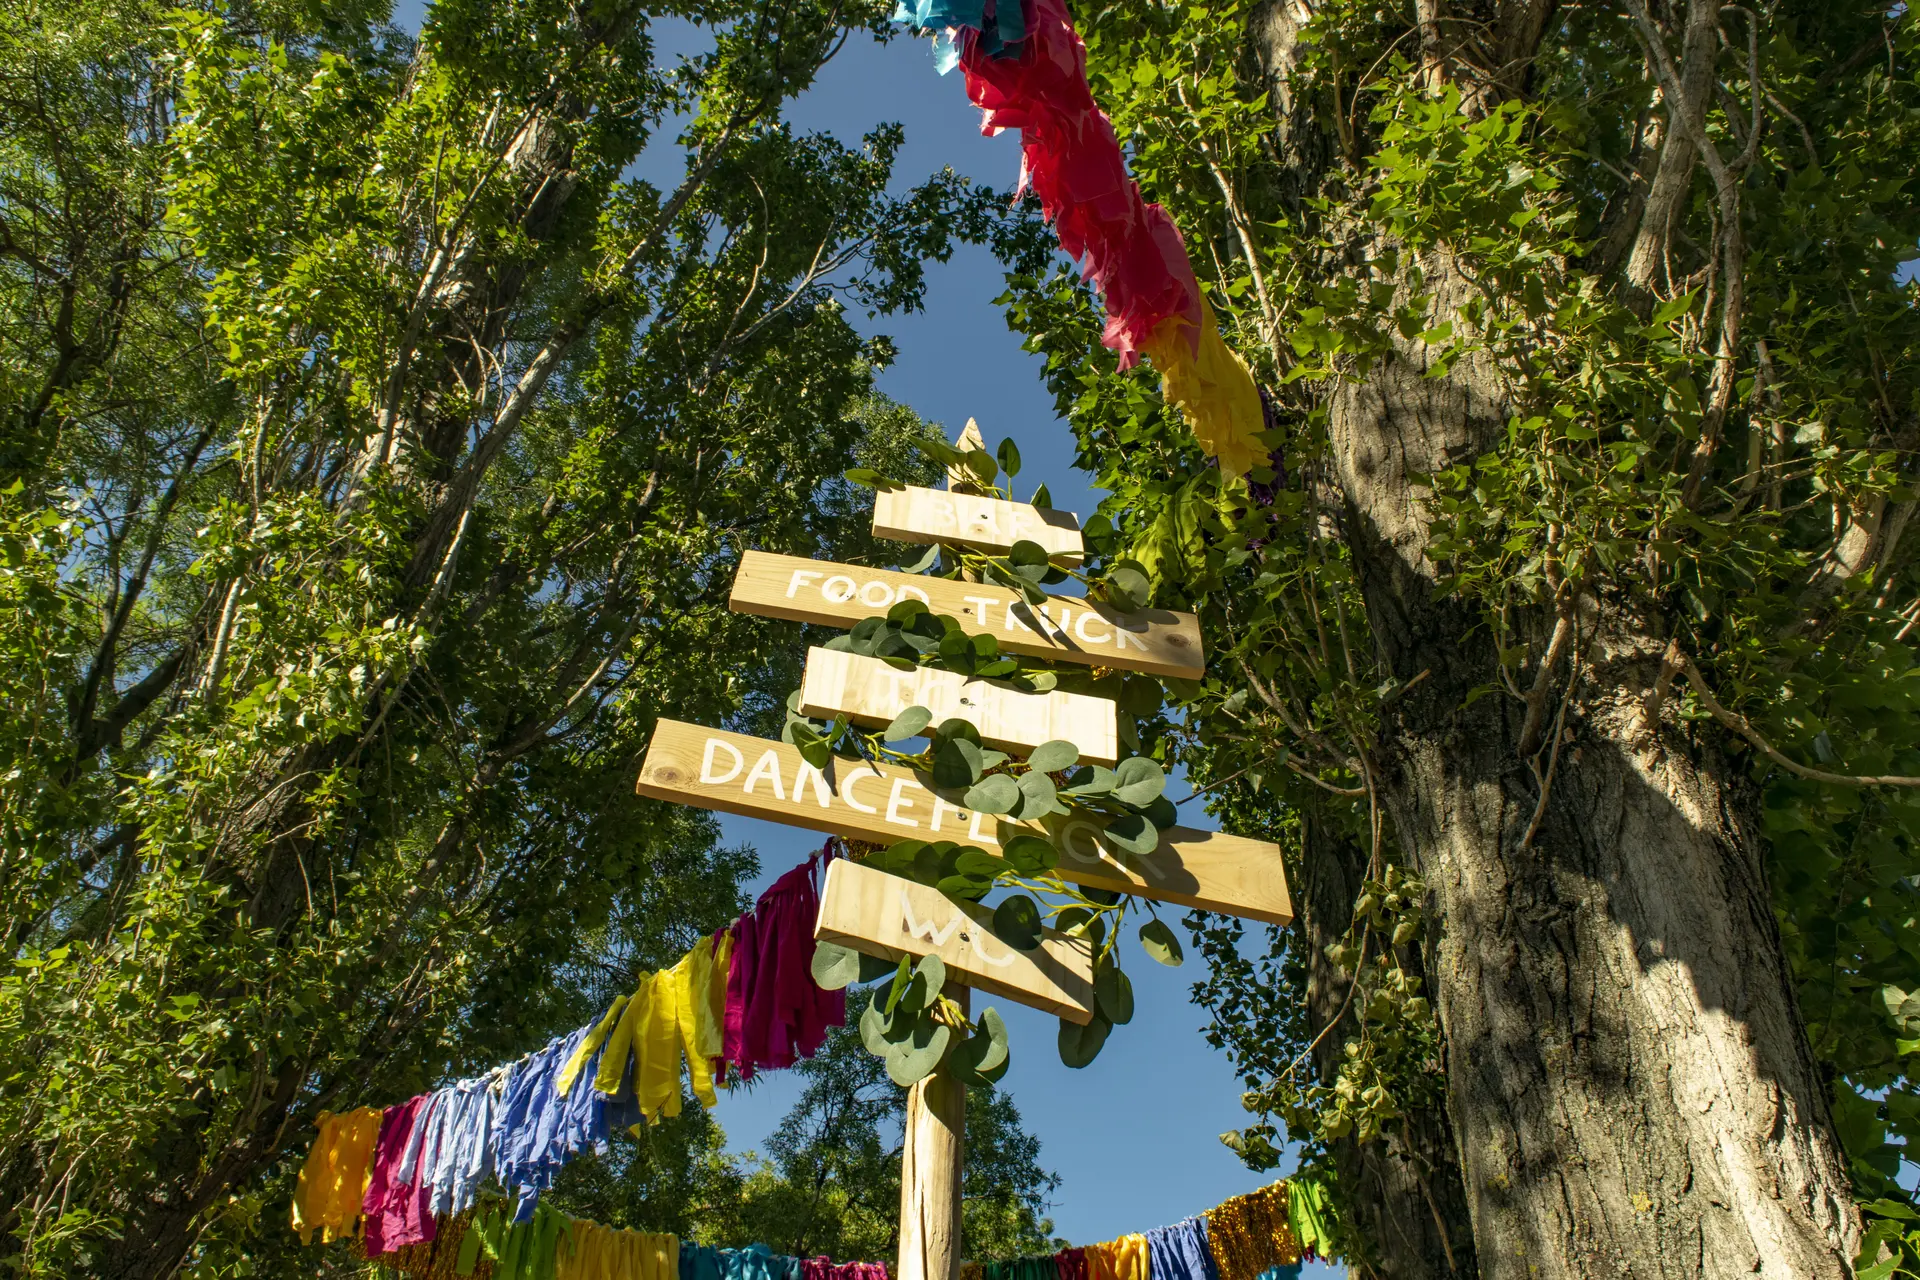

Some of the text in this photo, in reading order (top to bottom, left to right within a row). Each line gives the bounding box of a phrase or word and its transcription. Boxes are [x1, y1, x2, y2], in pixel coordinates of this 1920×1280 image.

[928, 497, 1035, 539] BAR
[785, 569, 1150, 651] FOOD TRUCK
[901, 889, 1016, 967] WC
